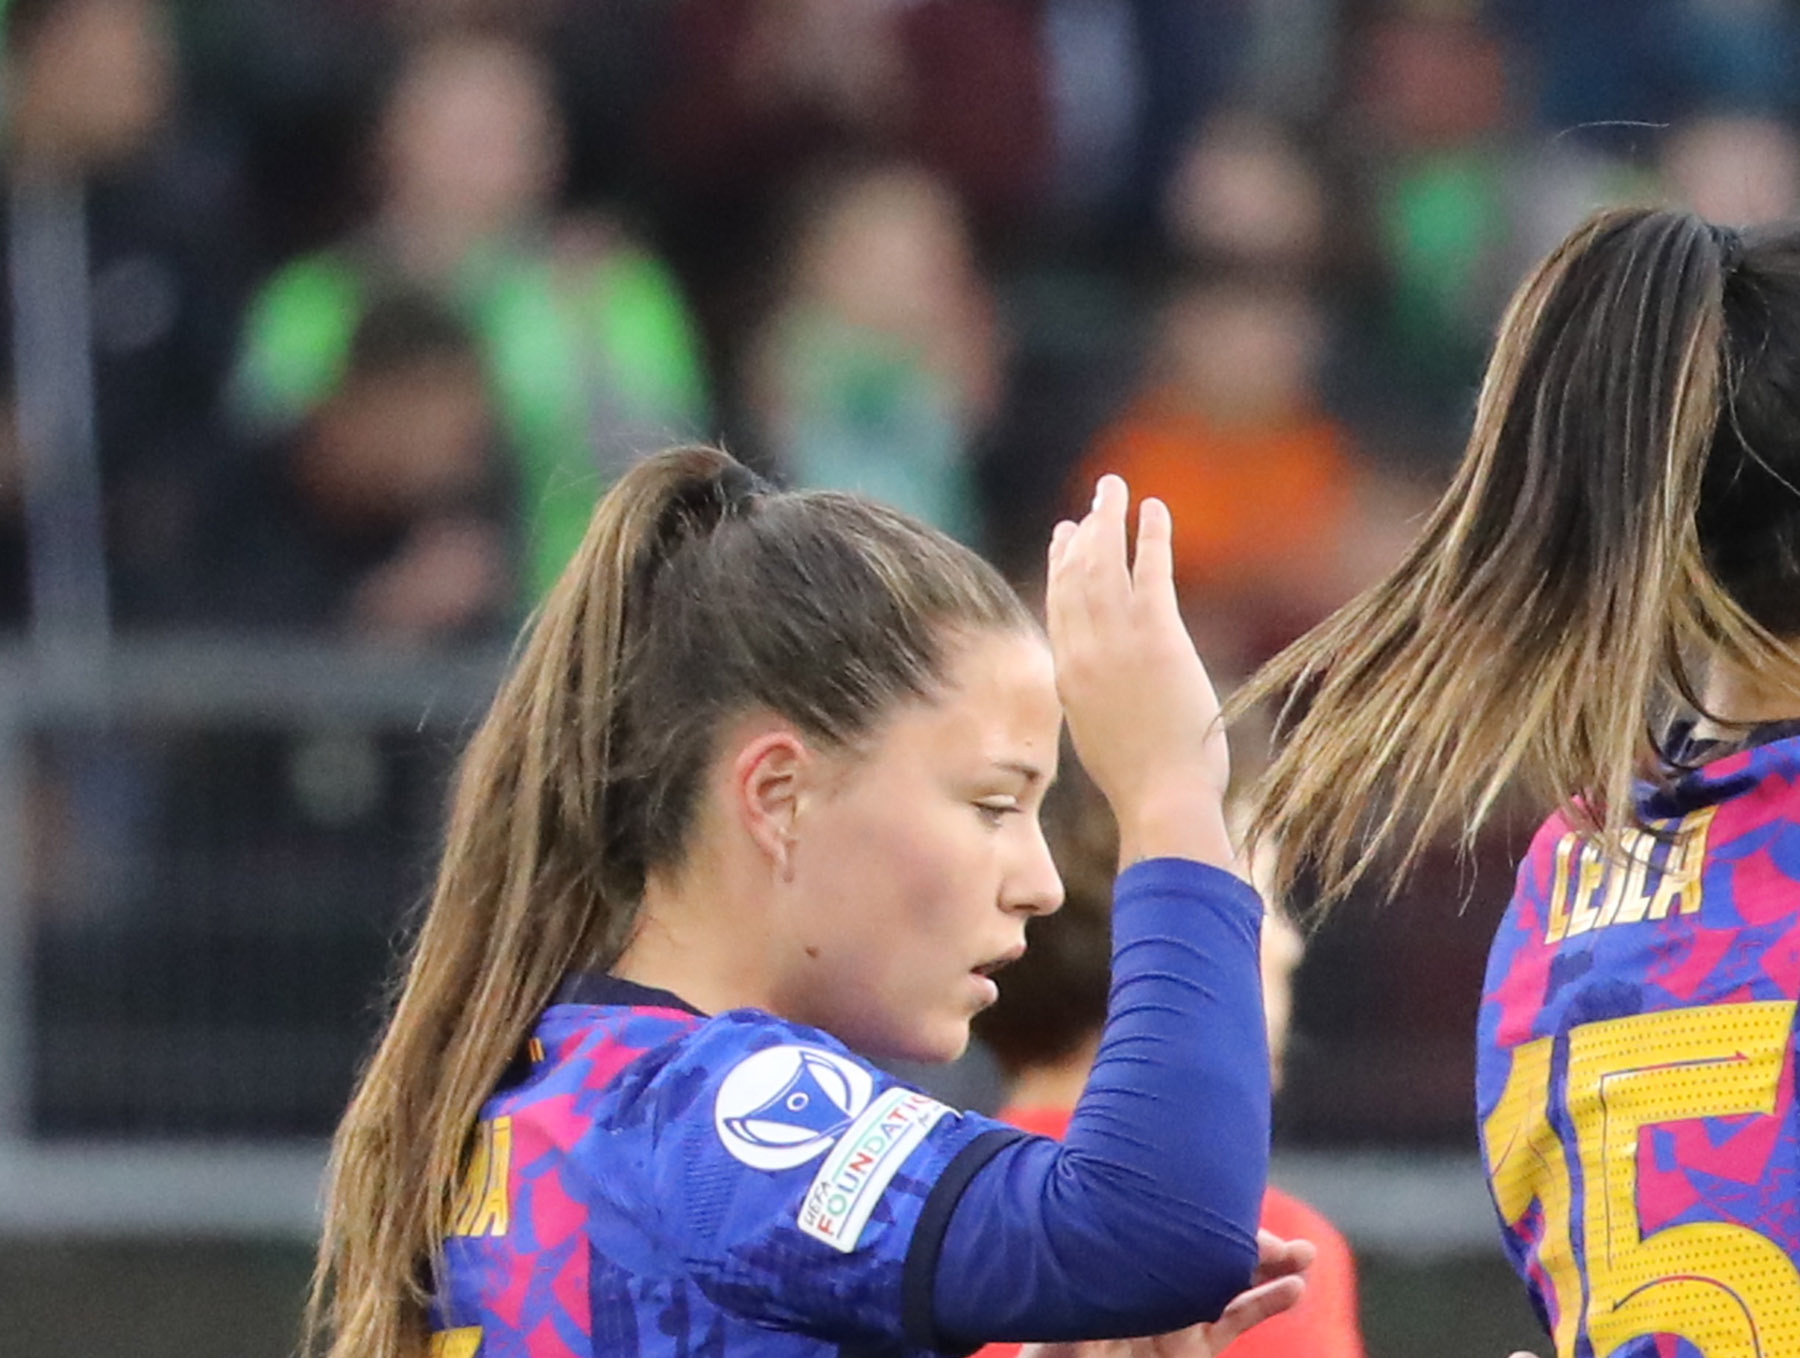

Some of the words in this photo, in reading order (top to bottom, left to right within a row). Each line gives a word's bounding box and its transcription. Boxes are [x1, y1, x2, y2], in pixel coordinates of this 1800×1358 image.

[1545, 804, 1719, 945] LEILA
[803, 1180, 831, 1227] UEFA
[817, 1094, 932, 1237] FOUNDATIO
